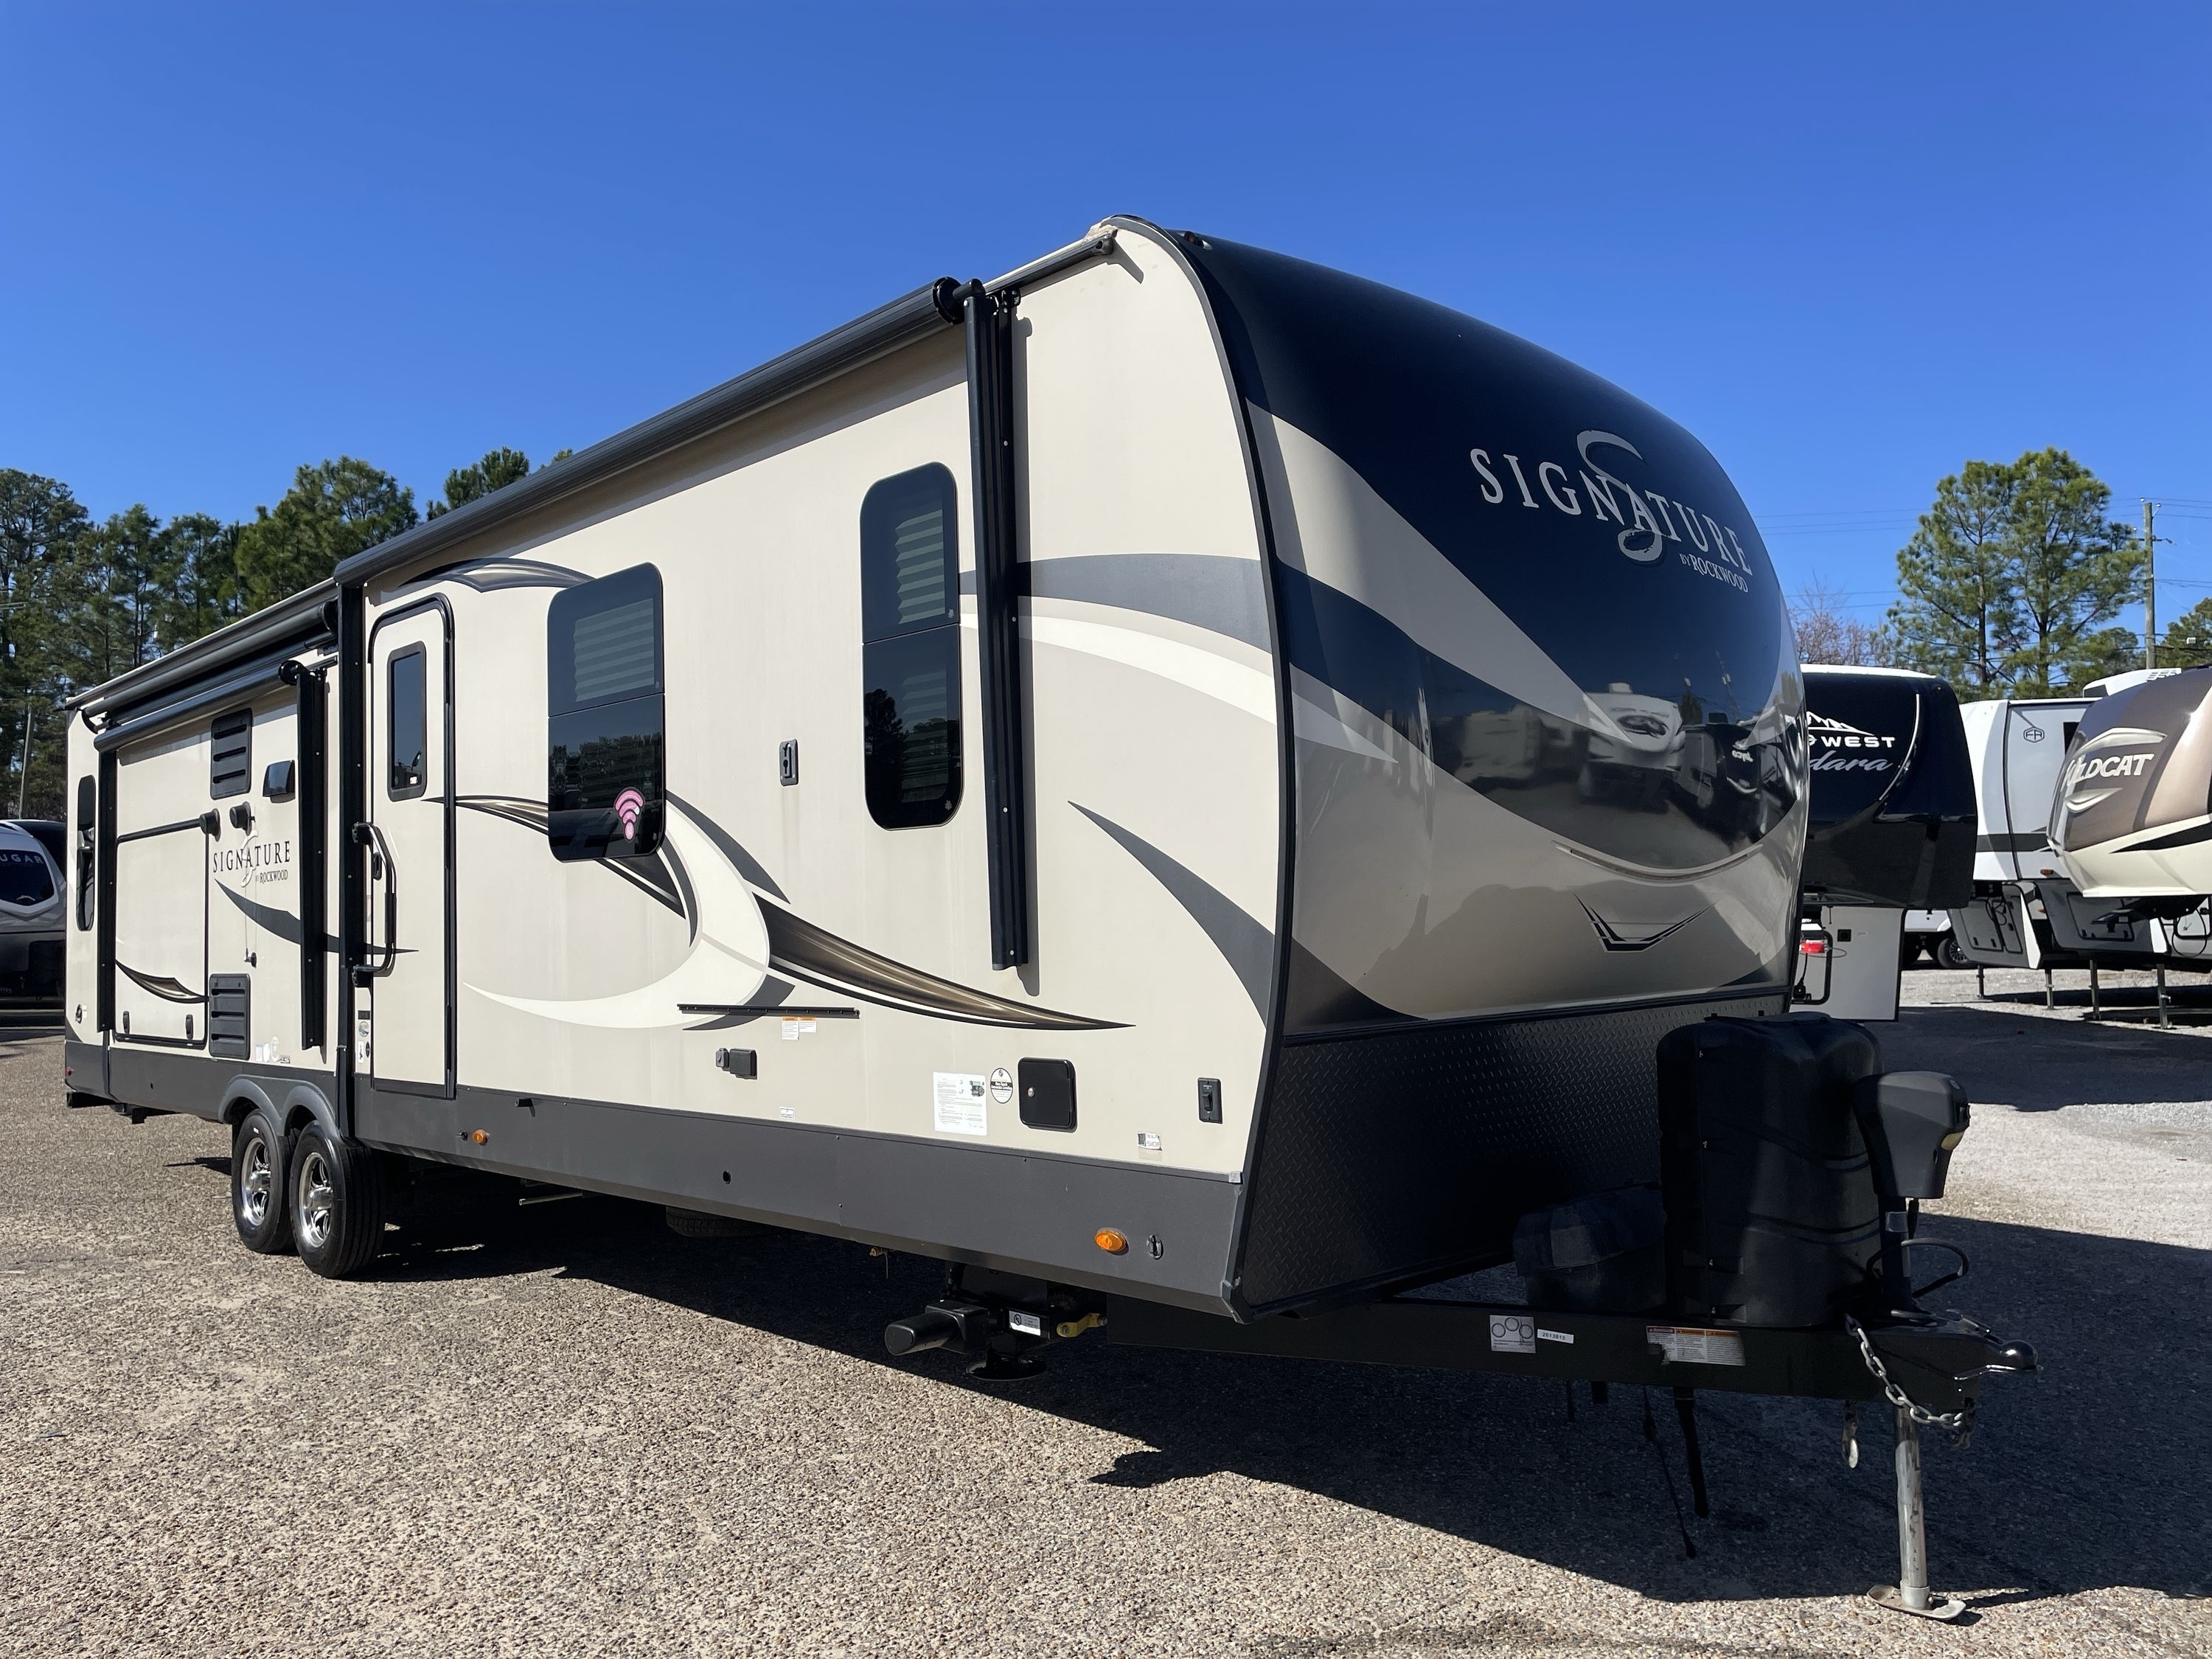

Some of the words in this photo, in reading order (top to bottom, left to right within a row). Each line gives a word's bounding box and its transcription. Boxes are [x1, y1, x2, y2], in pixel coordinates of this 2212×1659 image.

[1470, 448, 1753, 577] SIGNATURE
[1679, 553, 1691, 566] BY
[1688, 553, 1748, 594] ROCKWOOD
[1820, 737, 1895, 748] WEST
[1809, 750, 1893, 771] dara
[0, 854, 44, 863] UGAR
[213, 841, 291, 873] SIGNATURE
[260, 869, 288, 884] ROCKWOOD
